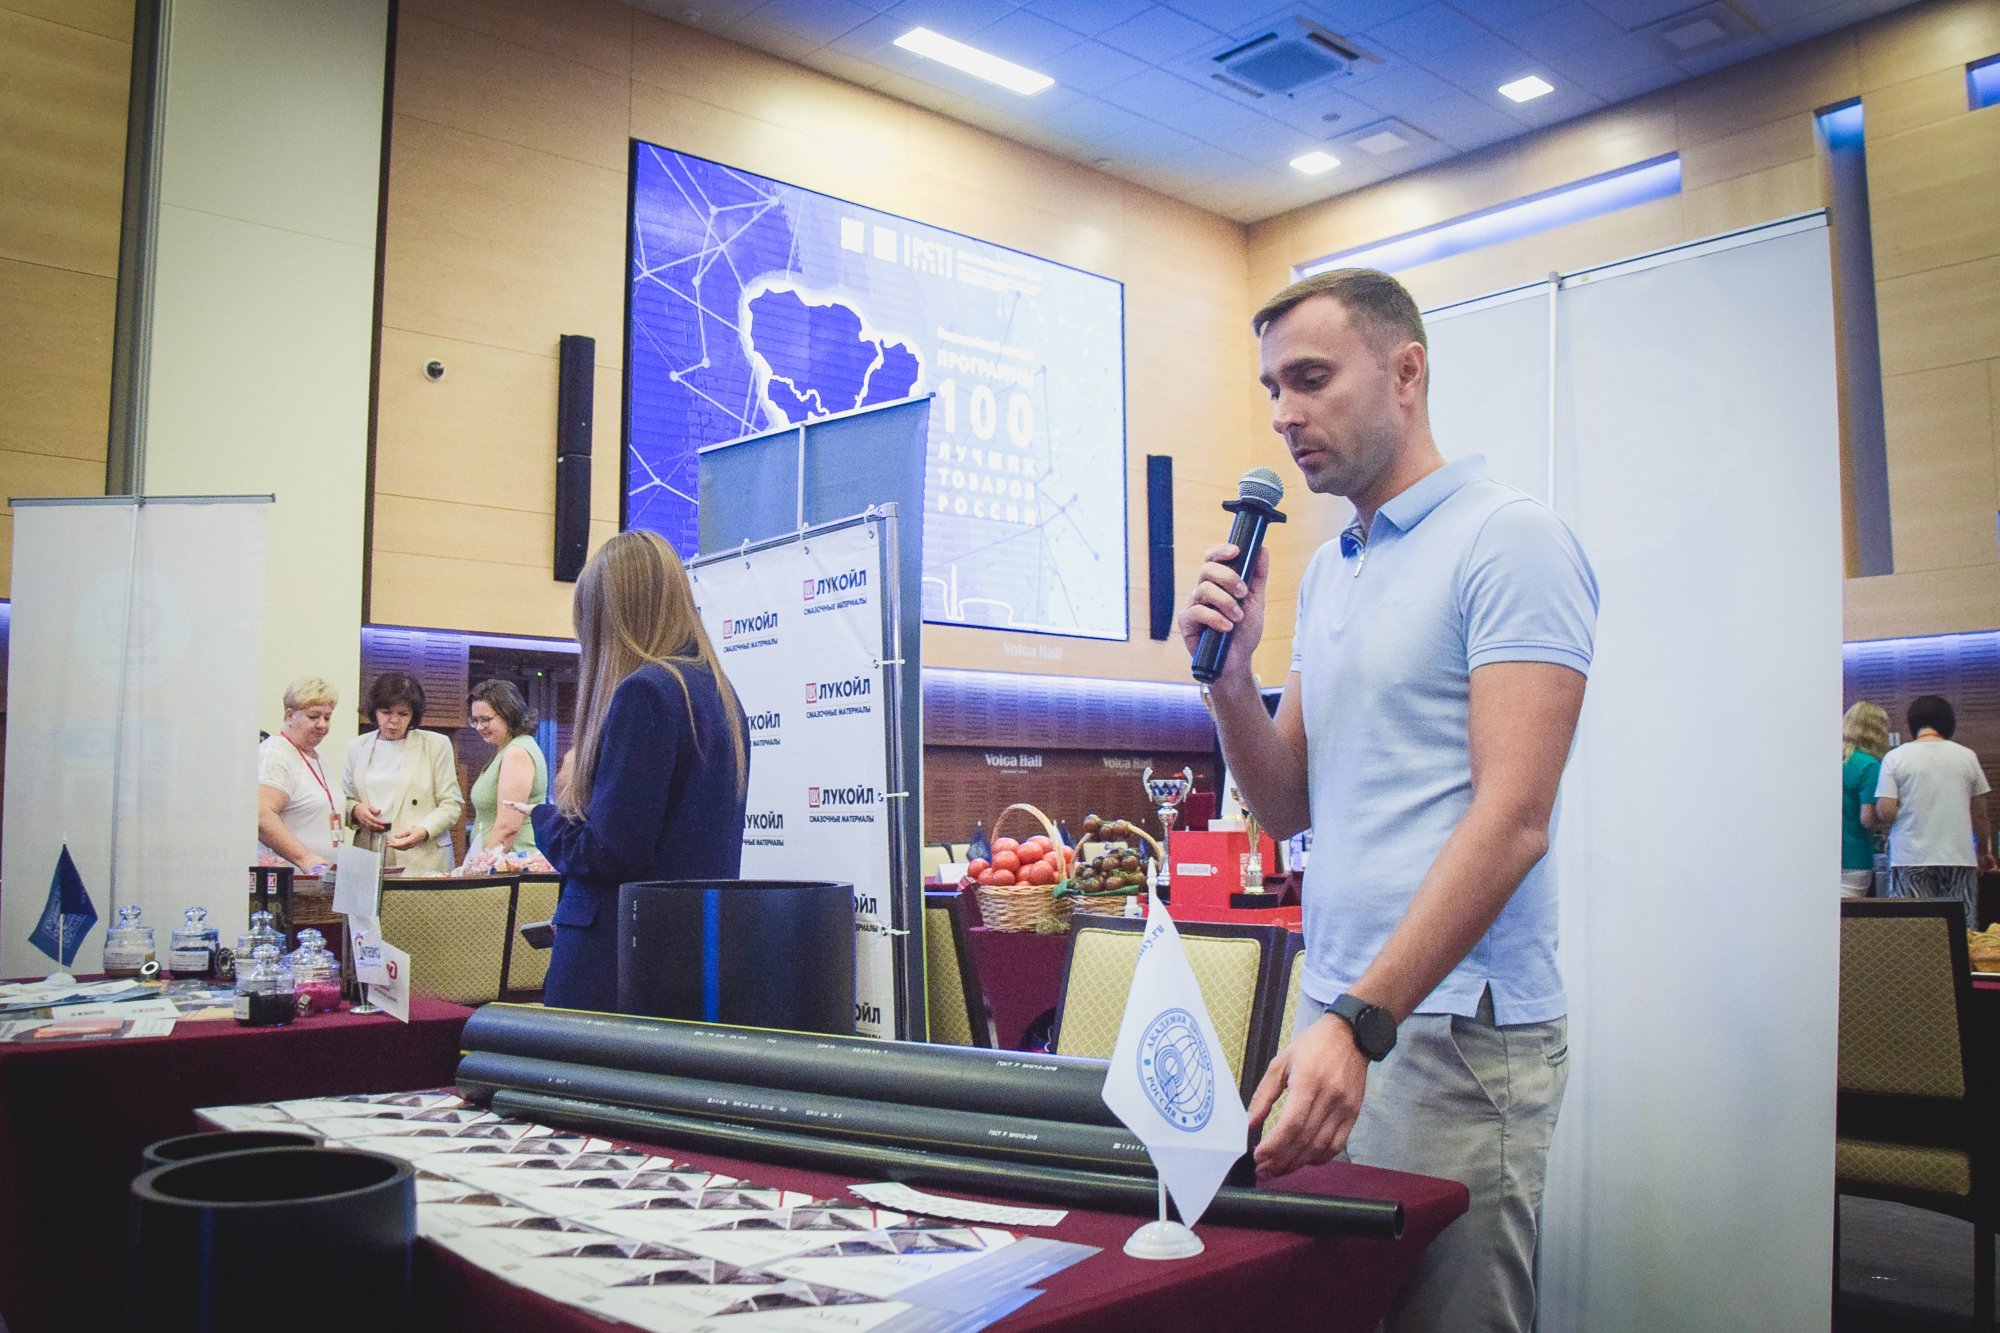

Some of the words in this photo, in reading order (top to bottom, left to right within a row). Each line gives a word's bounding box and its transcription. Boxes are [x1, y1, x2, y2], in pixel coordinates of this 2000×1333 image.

[938, 377, 1034, 449] 100
[937, 467, 1036, 501] ТОВАРОВ
[938, 493, 1037, 526] РОССИИ
[816, 569, 867, 596] ЛУКОЙЛ
[803, 603, 836, 616] СМАЗОЧНЫЕ
[836, 597, 867, 610] МАТЕРИАЛЫ
[733, 611, 778, 635] ЛУКОЙЛ
[819, 676, 871, 700] ЛУКОЙЛ
[806, 708, 837, 719] СМАЗОЧНЫЕ
[838, 705, 871, 716] МАТЕРИАЛЫ
[821, 785, 874, 805] ЛУКОЙЛ
[809, 815, 841, 823] СМАЗОЧНЫЕ
[841, 815, 875, 823] МАТЕРИАЛЫ
[1146, 1014, 1187, 1049] АКАДЕМИЯ
[1146, 1076, 1178, 1119] РОССИЯ
